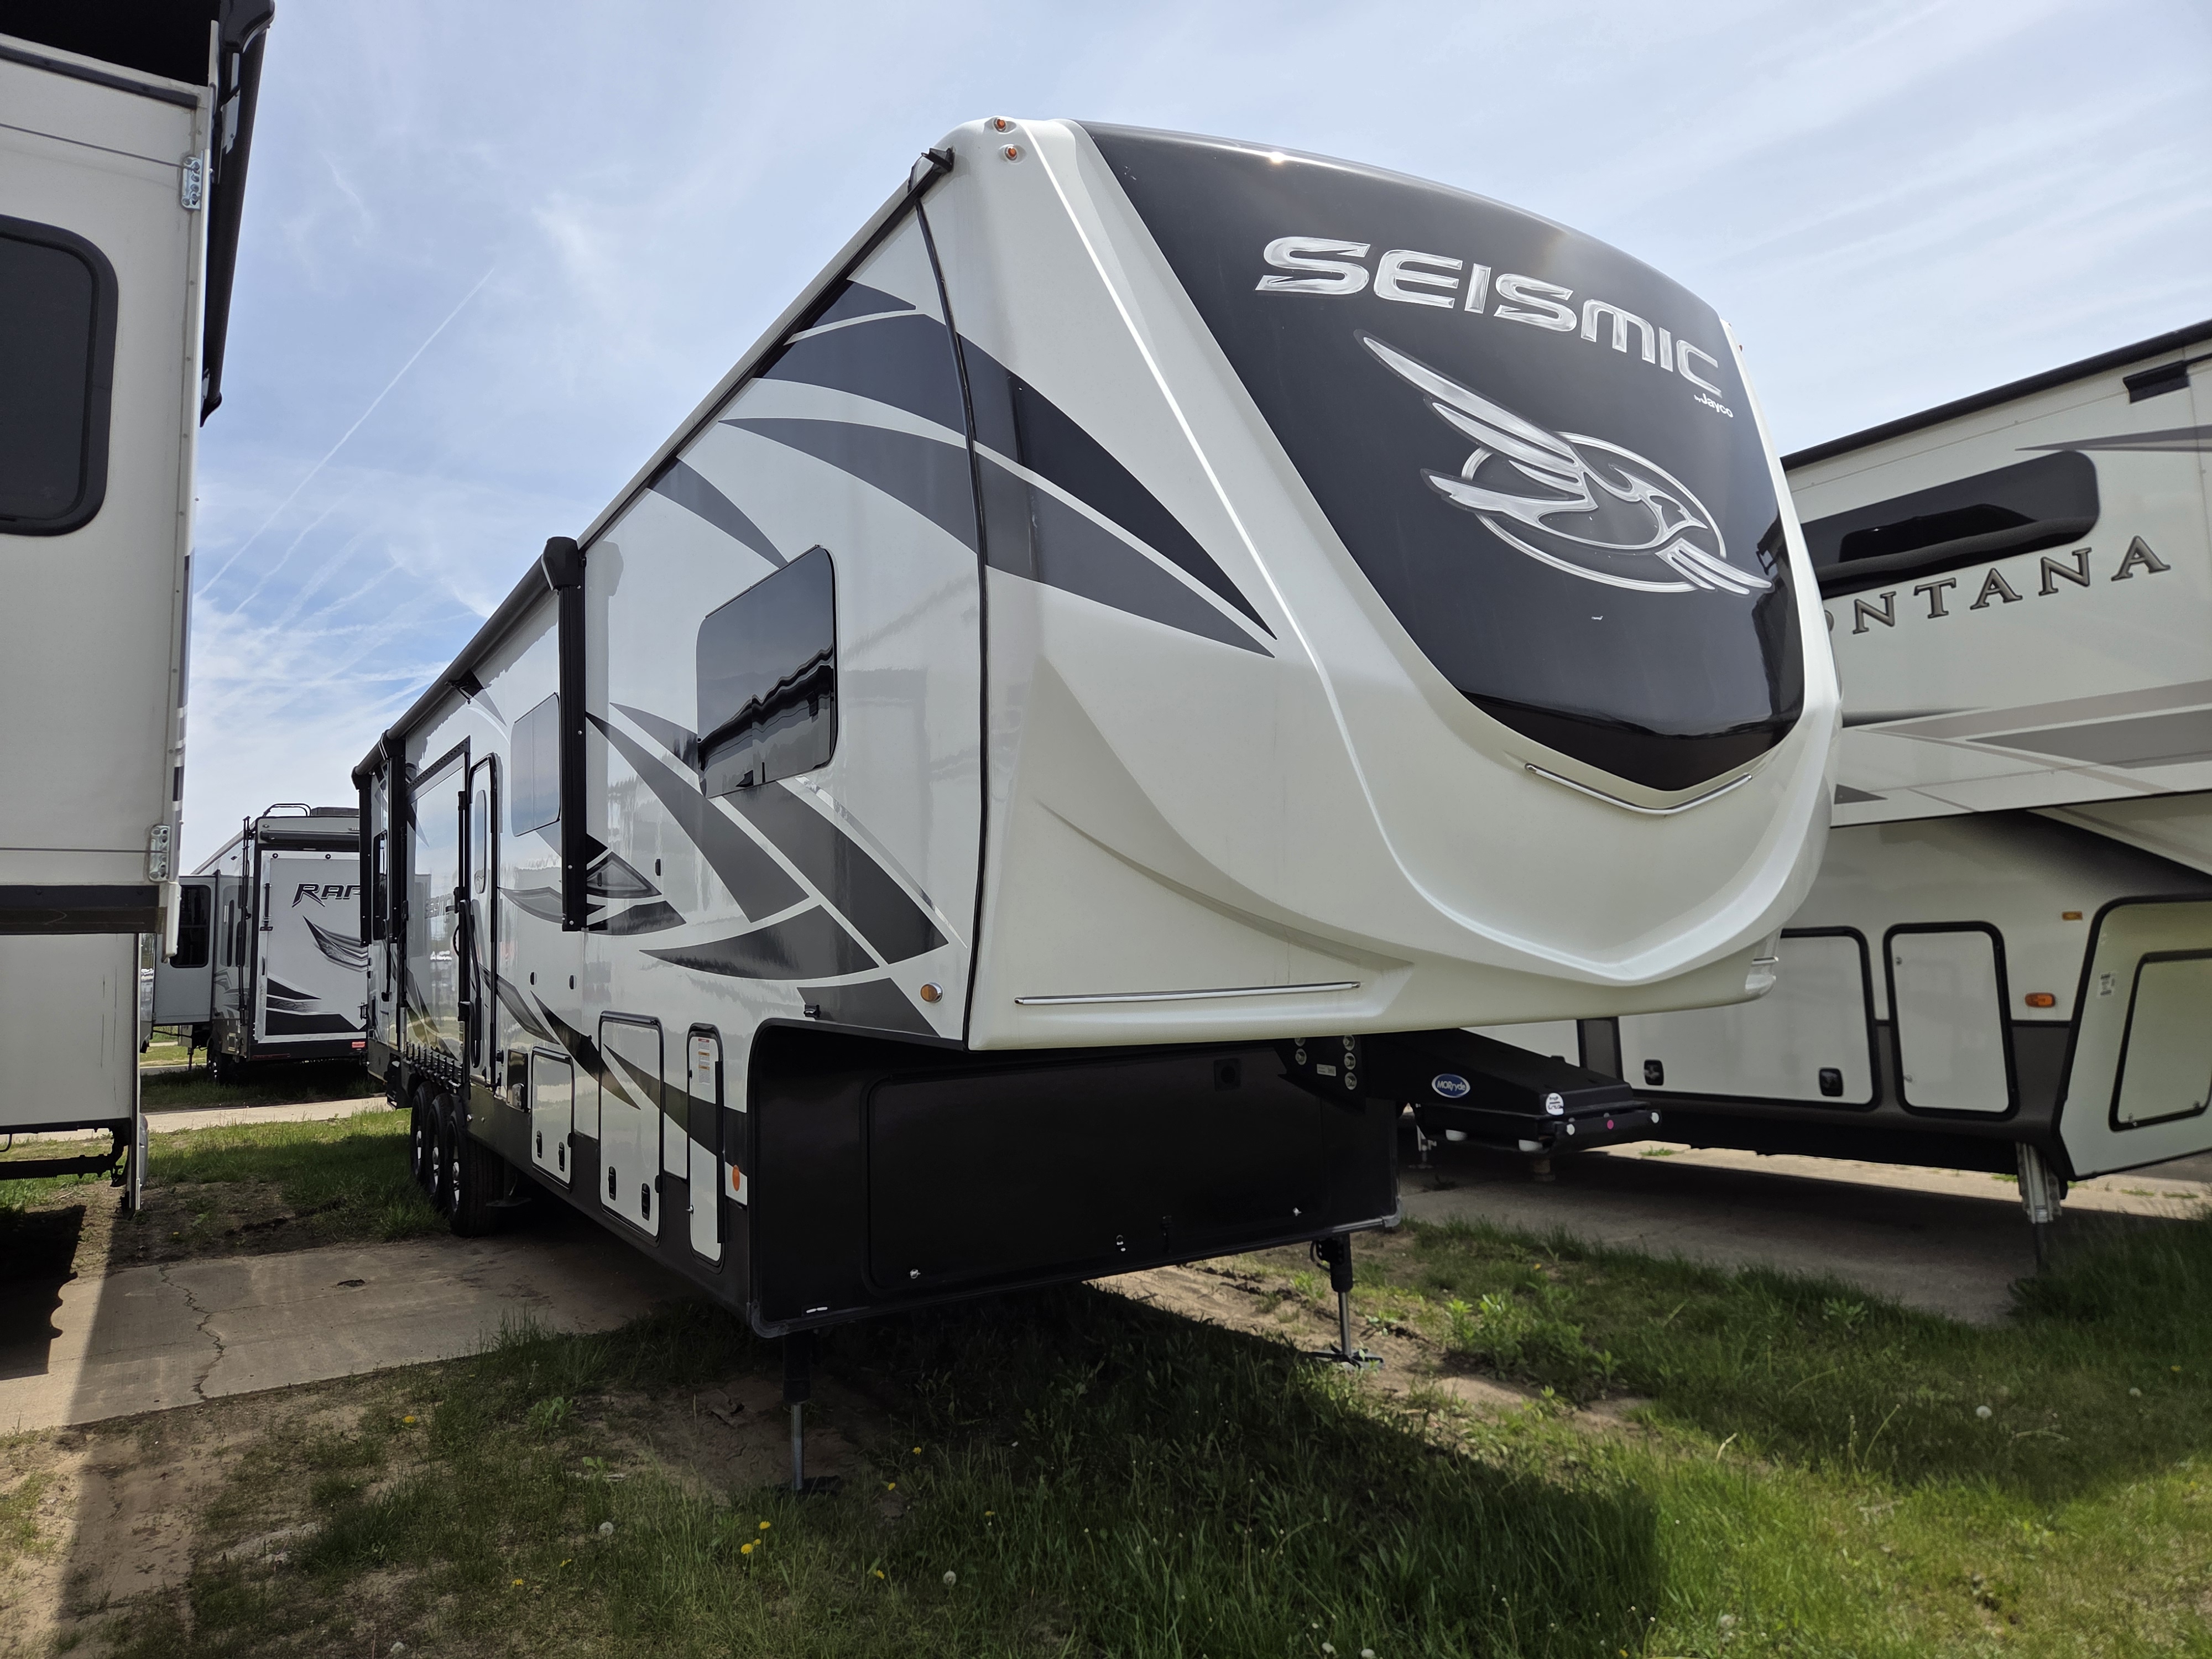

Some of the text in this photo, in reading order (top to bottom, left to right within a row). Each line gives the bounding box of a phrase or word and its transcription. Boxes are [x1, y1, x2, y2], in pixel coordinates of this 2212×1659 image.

[1255, 236, 1723, 399] SEISMIC
[1701, 393, 1734, 418] Jayco
[1824, 535, 2172, 635] NTANA
